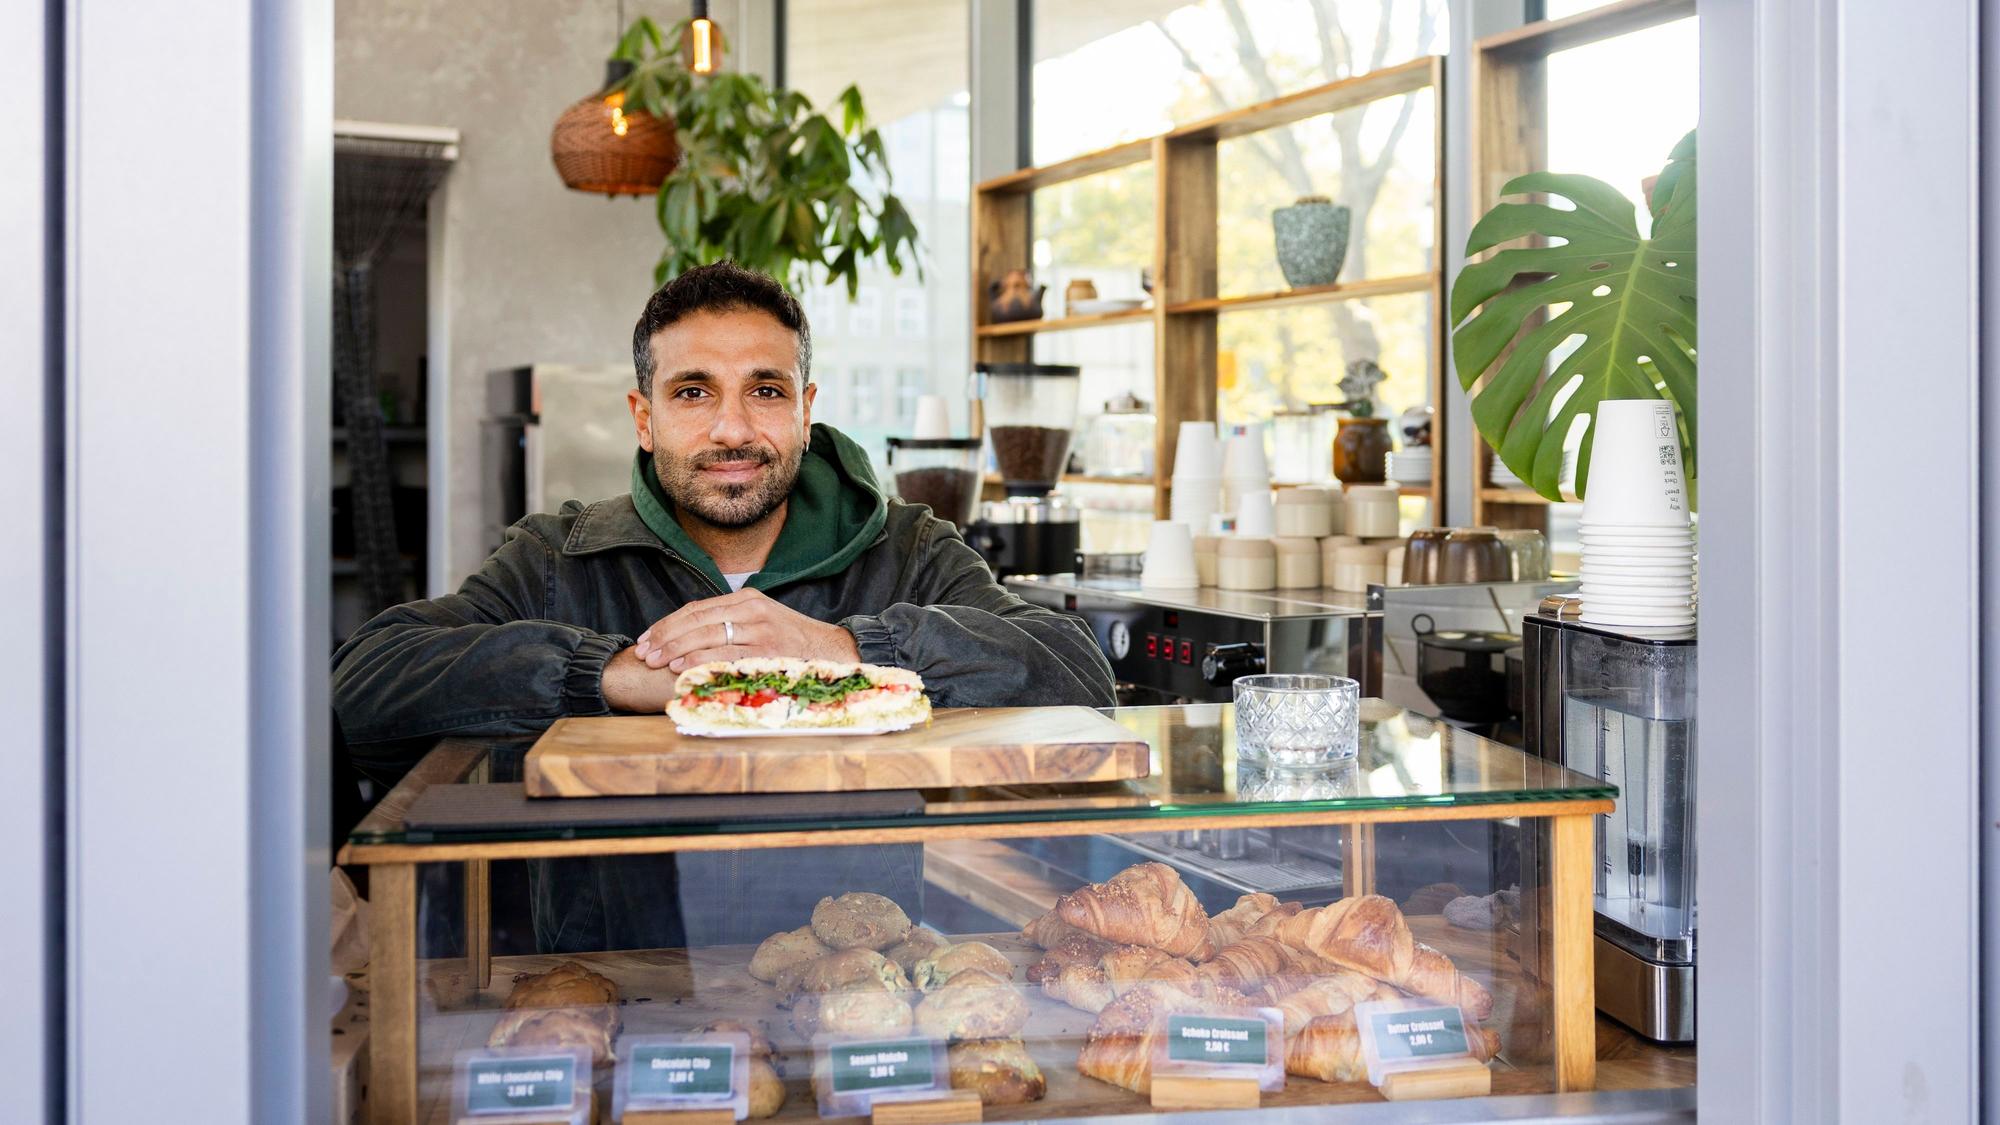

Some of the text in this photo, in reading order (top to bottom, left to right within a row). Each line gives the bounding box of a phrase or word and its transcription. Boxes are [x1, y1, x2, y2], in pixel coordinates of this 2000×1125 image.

[1410, 1019, 1445, 1033] Croissant
[1182, 1027, 1249, 1041] Schoko Croissant
[849, 1055, 877, 1067] Sesam
